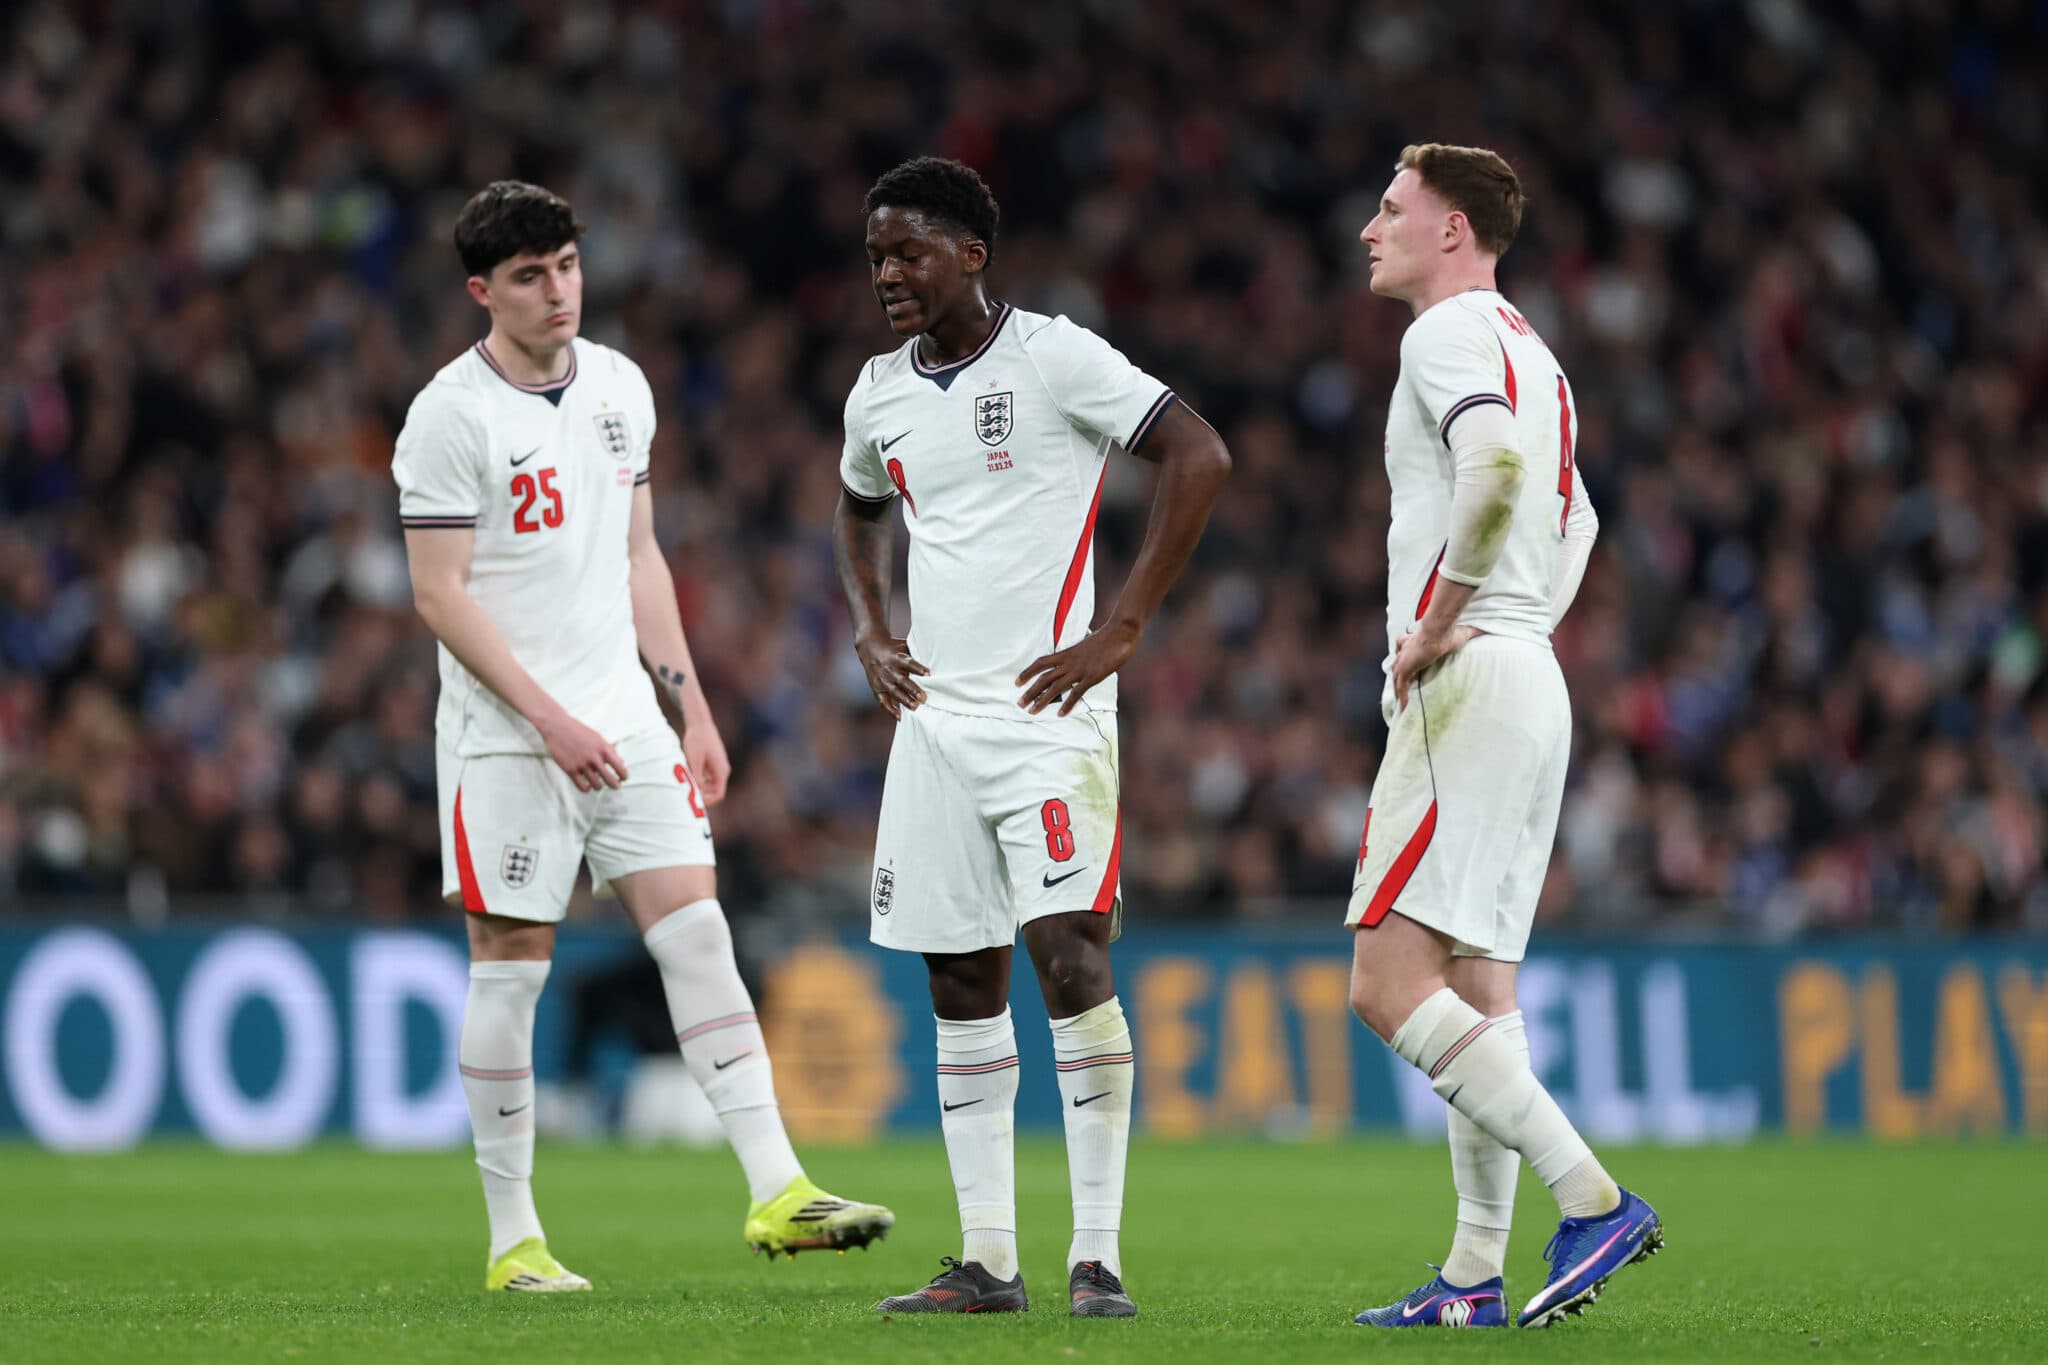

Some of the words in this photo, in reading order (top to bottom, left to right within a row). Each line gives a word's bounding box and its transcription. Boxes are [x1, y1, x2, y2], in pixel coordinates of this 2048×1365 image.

[986, 450, 1009, 461] JAPAN
[510, 466, 564, 534] 25
[1041, 797, 1076, 863] 8
[5, 927, 470, 1152] OOD
[1137, 956, 1353, 1142] EAT
